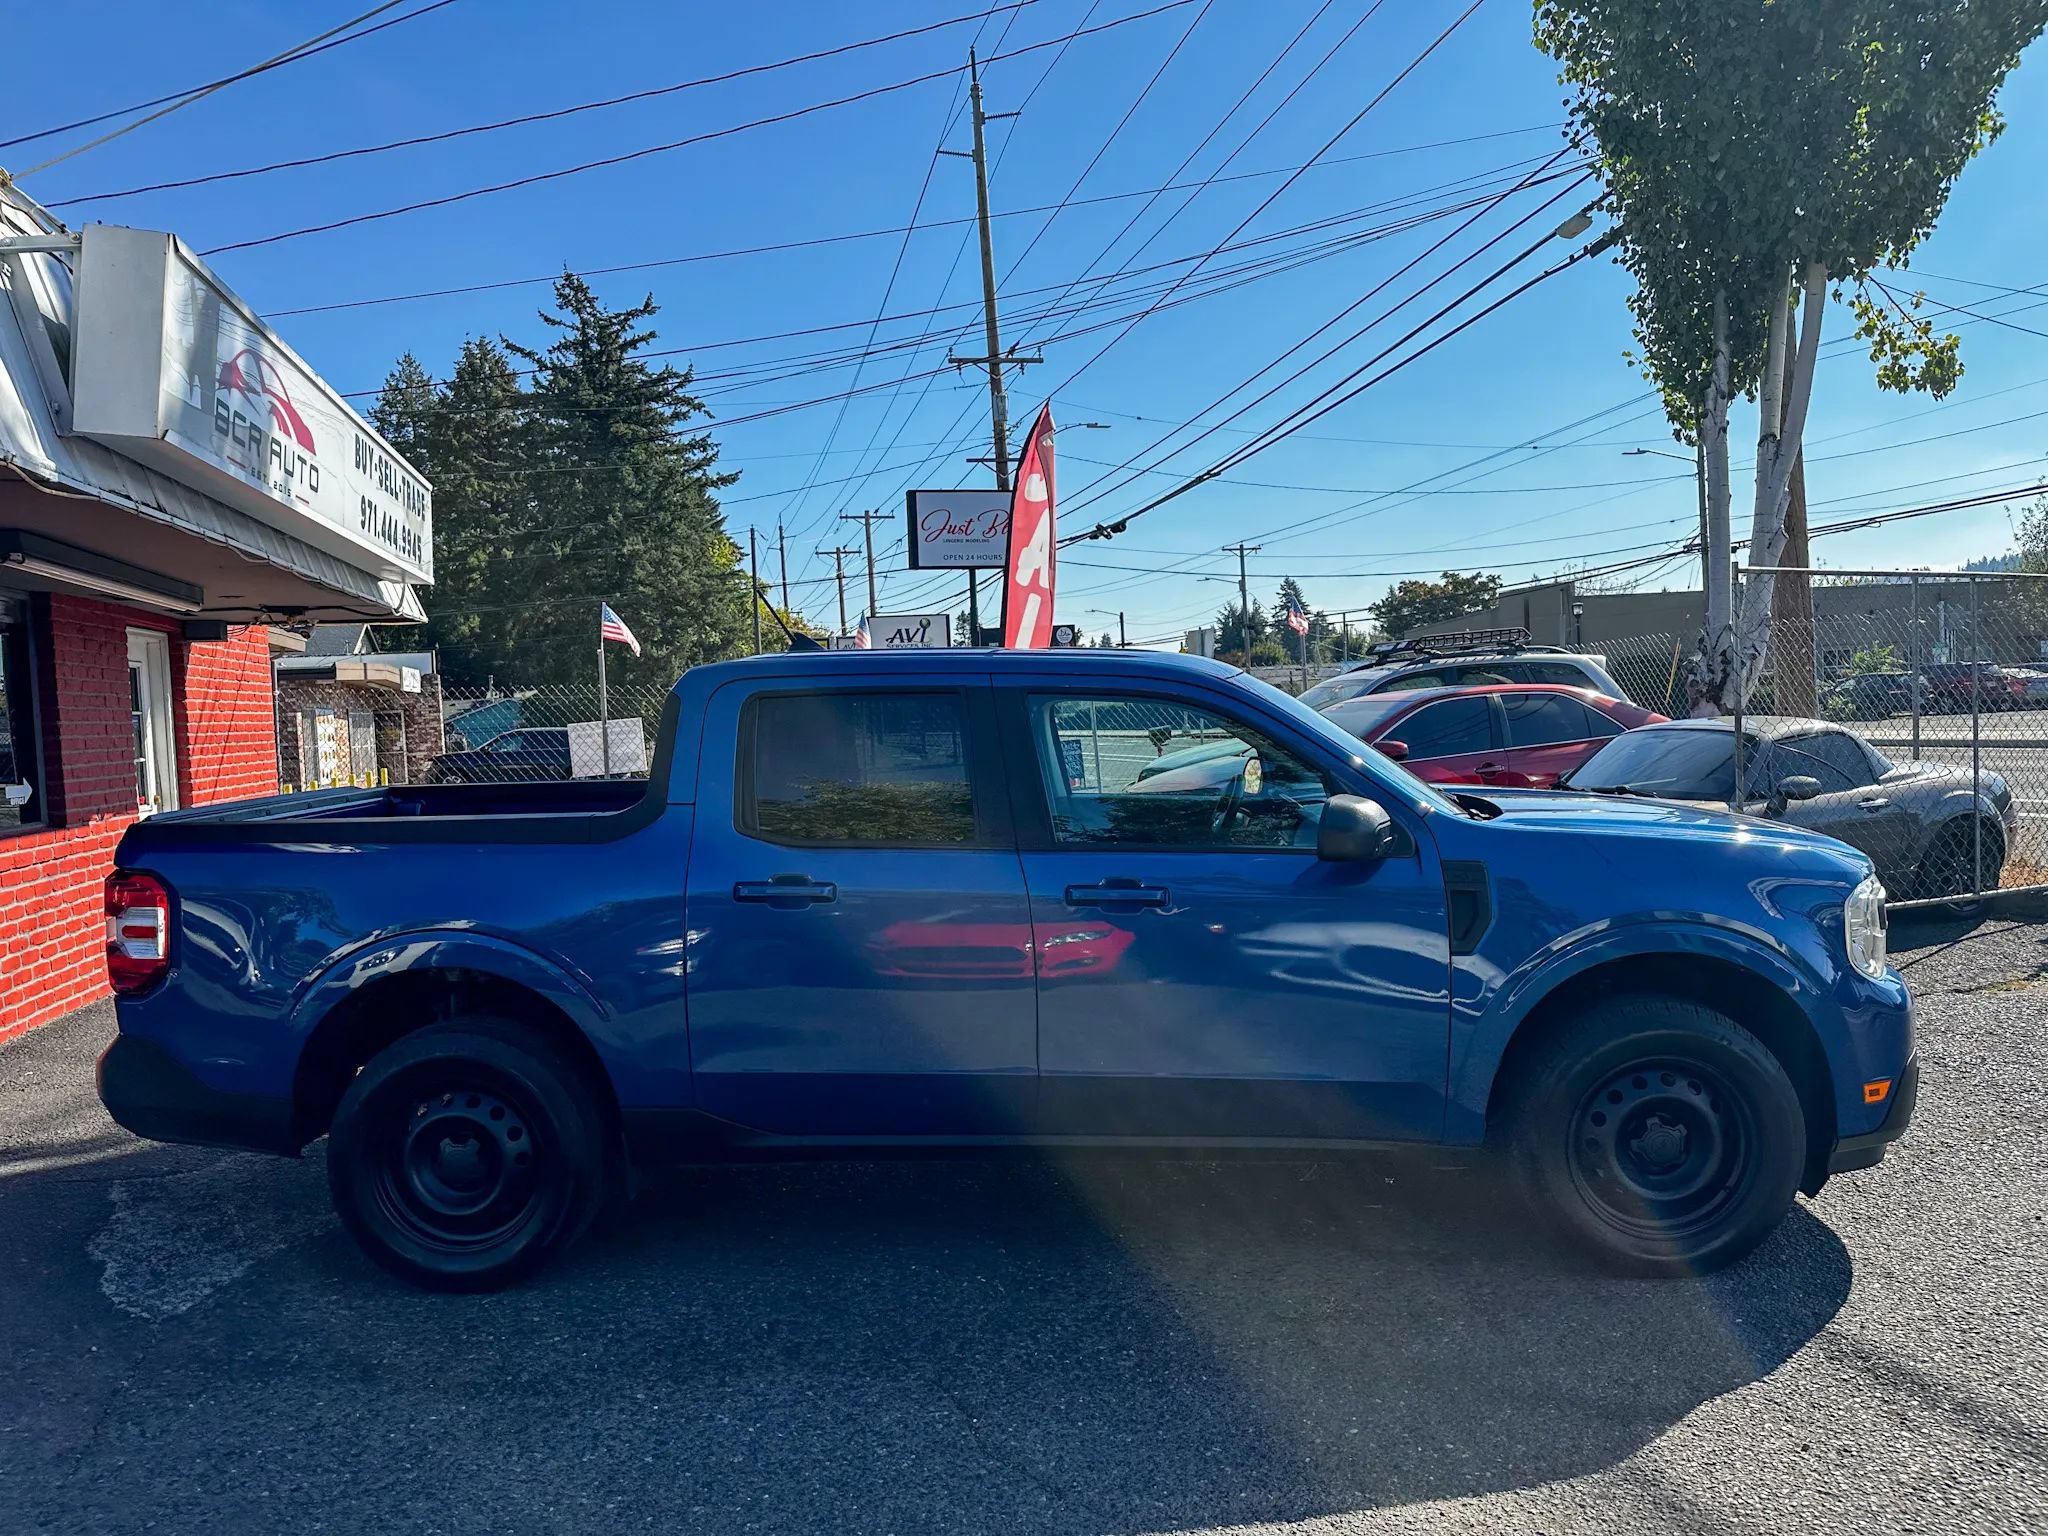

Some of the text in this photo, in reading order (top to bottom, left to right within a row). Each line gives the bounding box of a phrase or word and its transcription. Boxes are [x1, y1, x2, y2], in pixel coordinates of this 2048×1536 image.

[215, 397, 319, 493] BCR AUTO
[274, 481, 291, 497] 2015
[361, 495, 422, 564] 971.444.9945
[921, 508, 976, 543] Just
[976, 553, 1003, 561] HOURS
[885, 620, 931, 643] AVI
